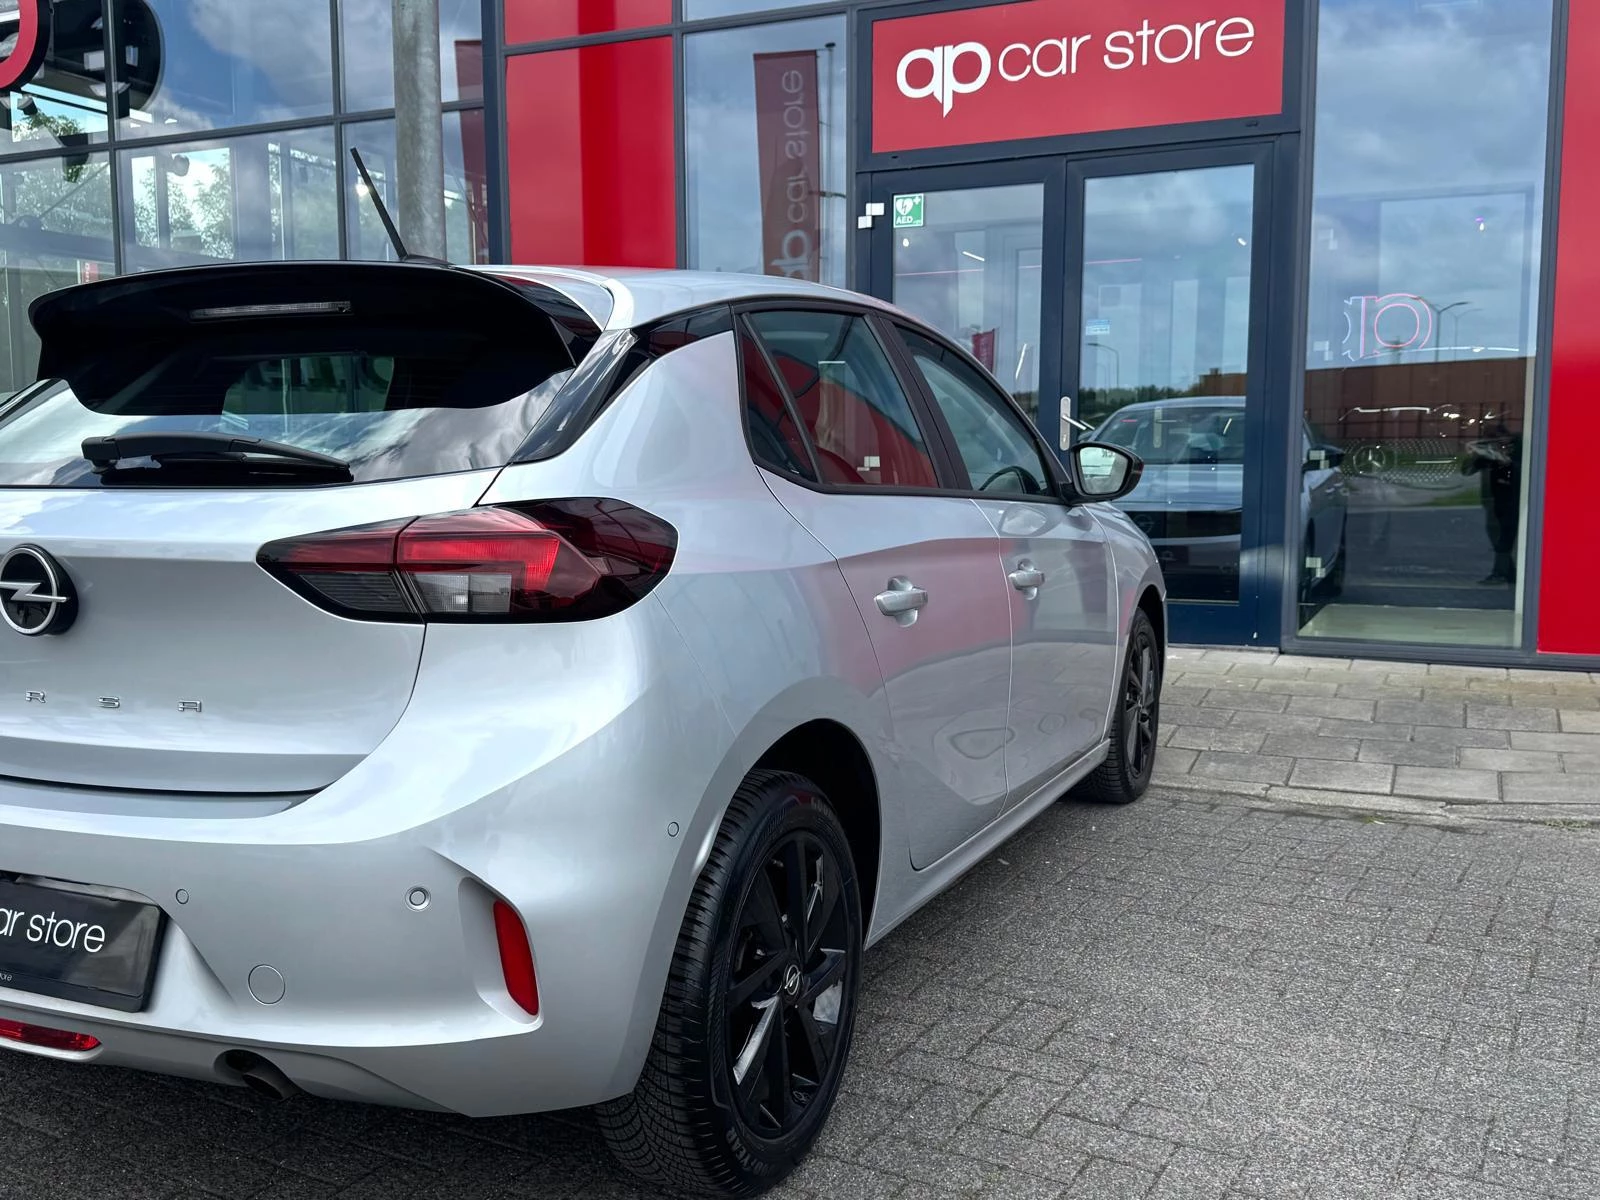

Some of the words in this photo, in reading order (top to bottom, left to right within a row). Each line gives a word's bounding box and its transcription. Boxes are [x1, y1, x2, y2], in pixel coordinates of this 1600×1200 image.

[896, 41, 992, 118] ap
[998, 34, 1092, 82] car
[1103, 16, 1255, 70] store
[895, 215, 914, 225] AED
[26, 911, 106, 953] store
